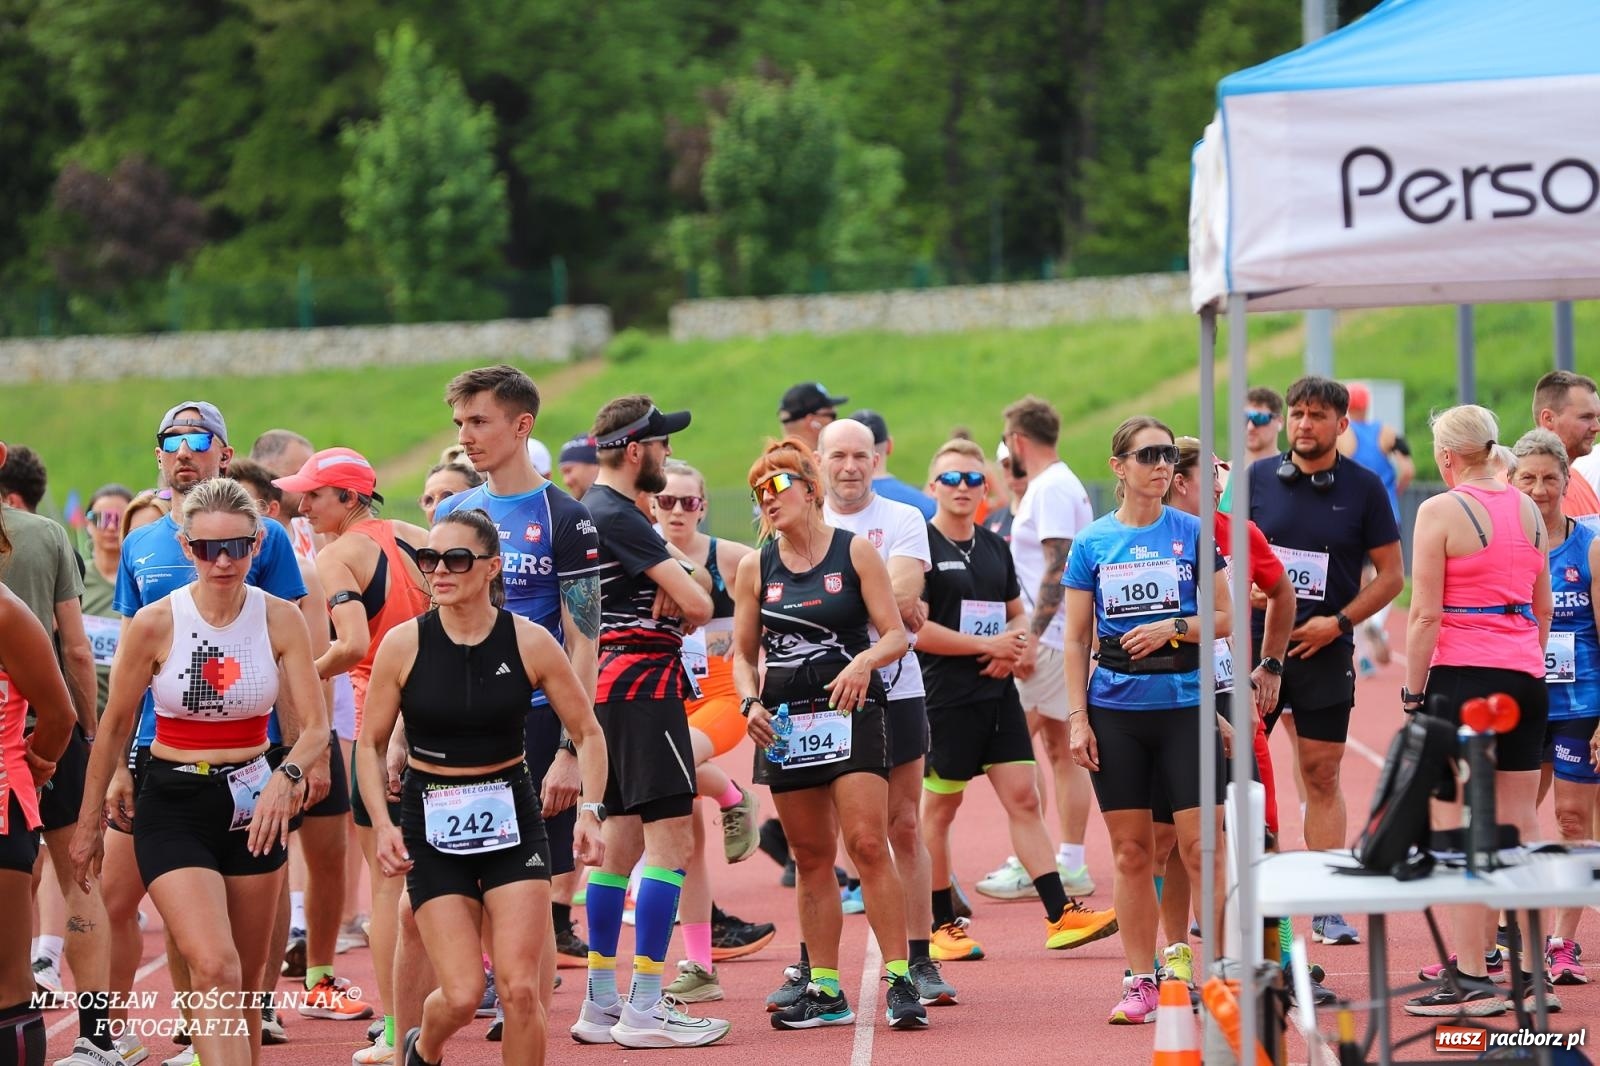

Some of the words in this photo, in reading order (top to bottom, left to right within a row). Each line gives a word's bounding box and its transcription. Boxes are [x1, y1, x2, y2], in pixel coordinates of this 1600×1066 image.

[1341, 146, 1600, 228] Perso
[500, 552, 552, 575] ERS
[504, 577, 527, 586] EAM
[1121, 582, 1159, 602] 180
[974, 620, 999, 637] 248
[799, 732, 834, 753] 194
[443, 788, 461, 798] BIEG
[462, 786, 477, 794] BEZ
[478, 783, 506, 793] GRANIC
[447, 811, 494, 837] 242
